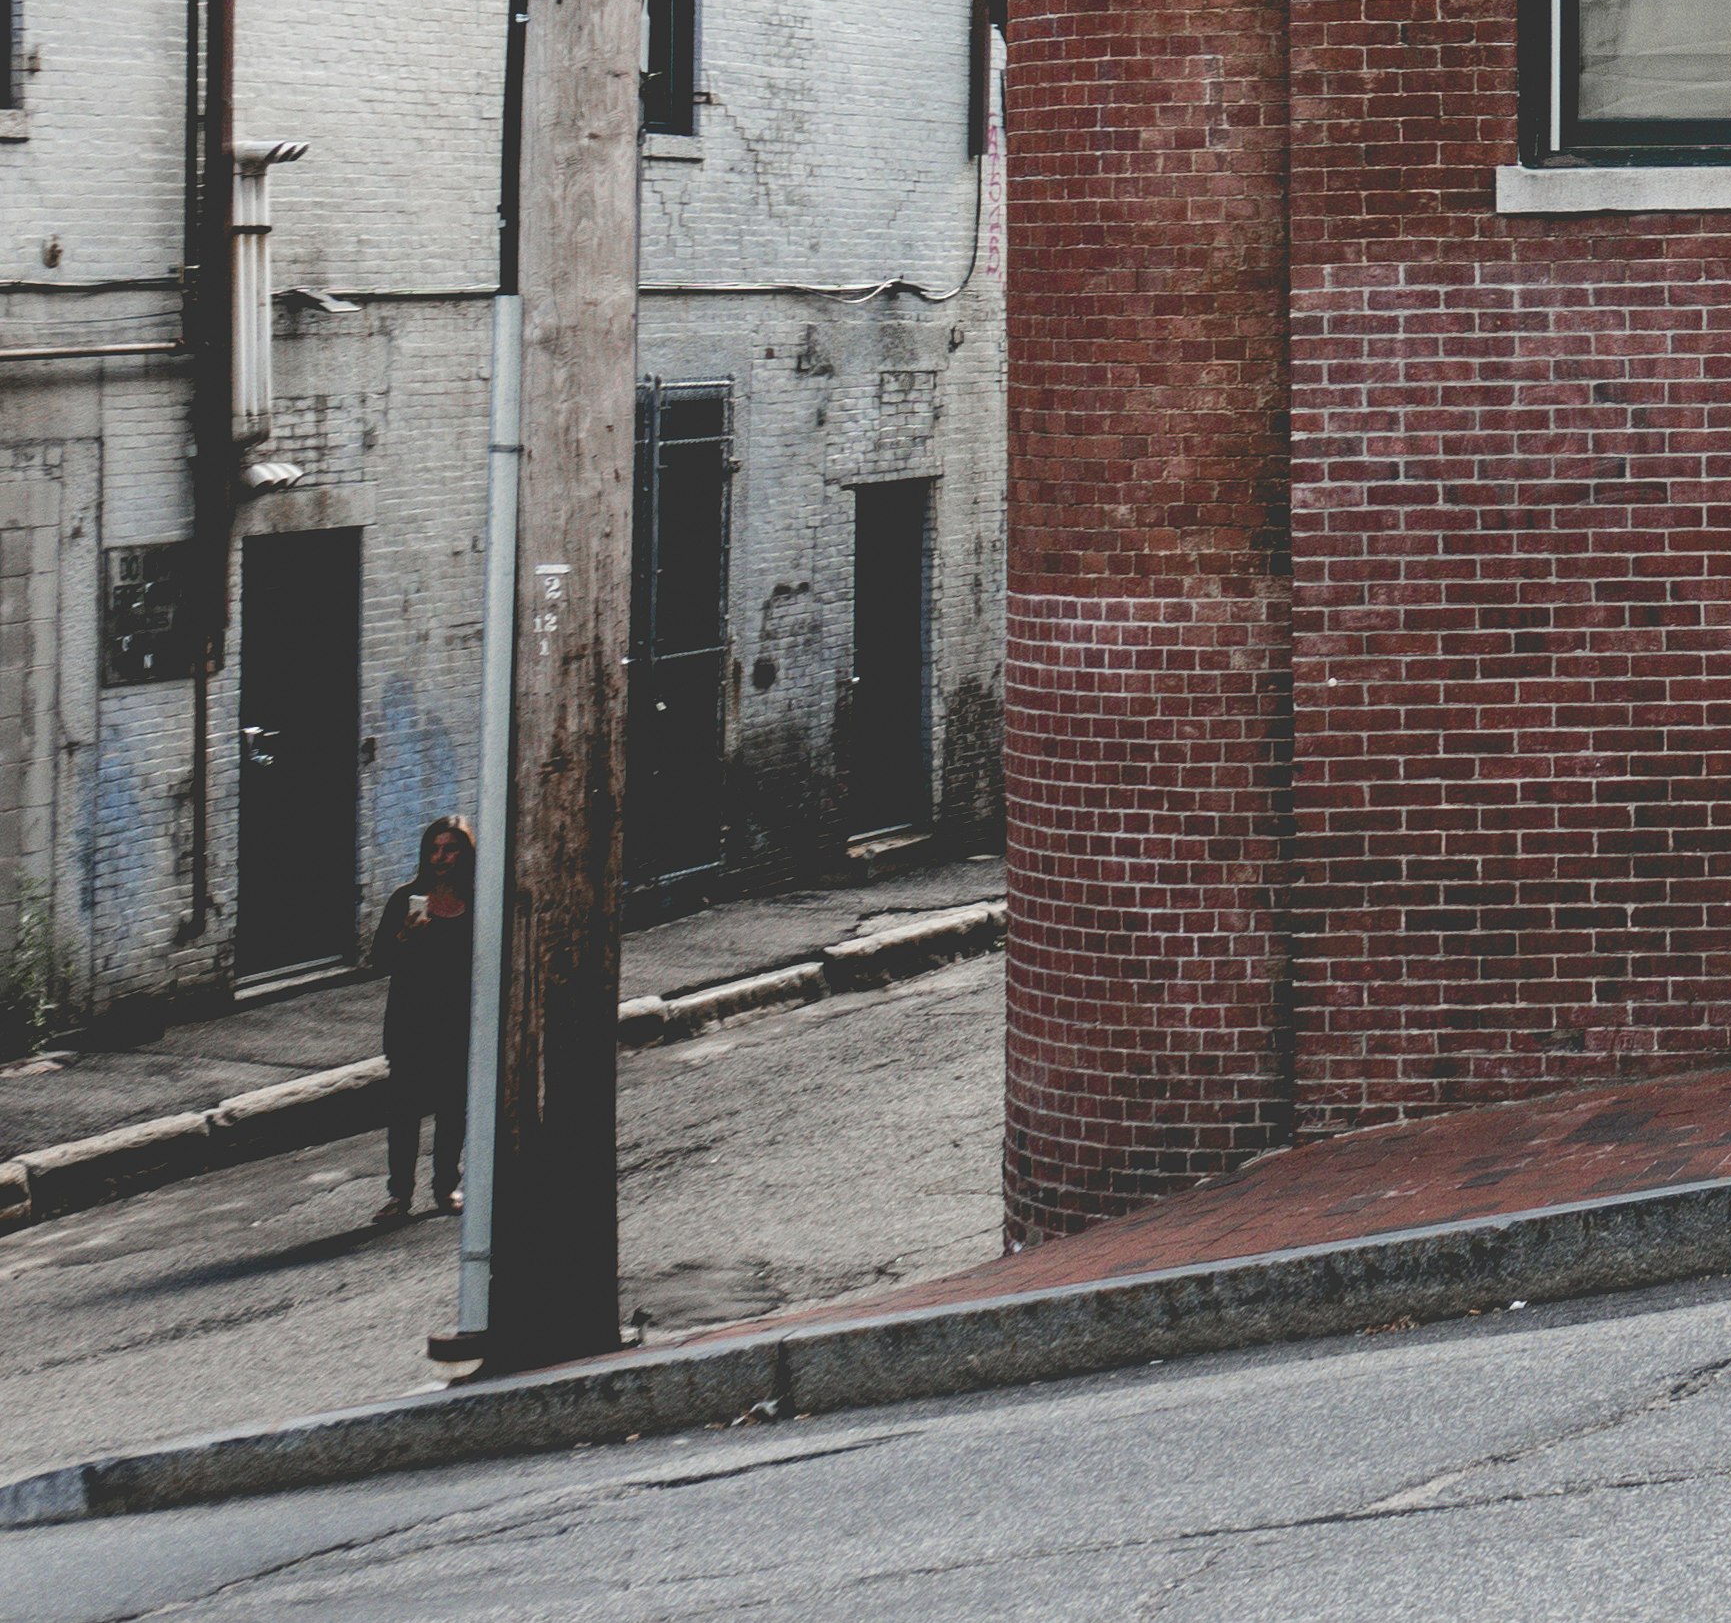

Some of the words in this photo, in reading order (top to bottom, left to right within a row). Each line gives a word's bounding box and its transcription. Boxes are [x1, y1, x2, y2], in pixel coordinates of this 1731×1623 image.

[544, 576, 562, 599] 2
[533, 612, 558, 633] 12
[540, 639, 550, 656] 1
